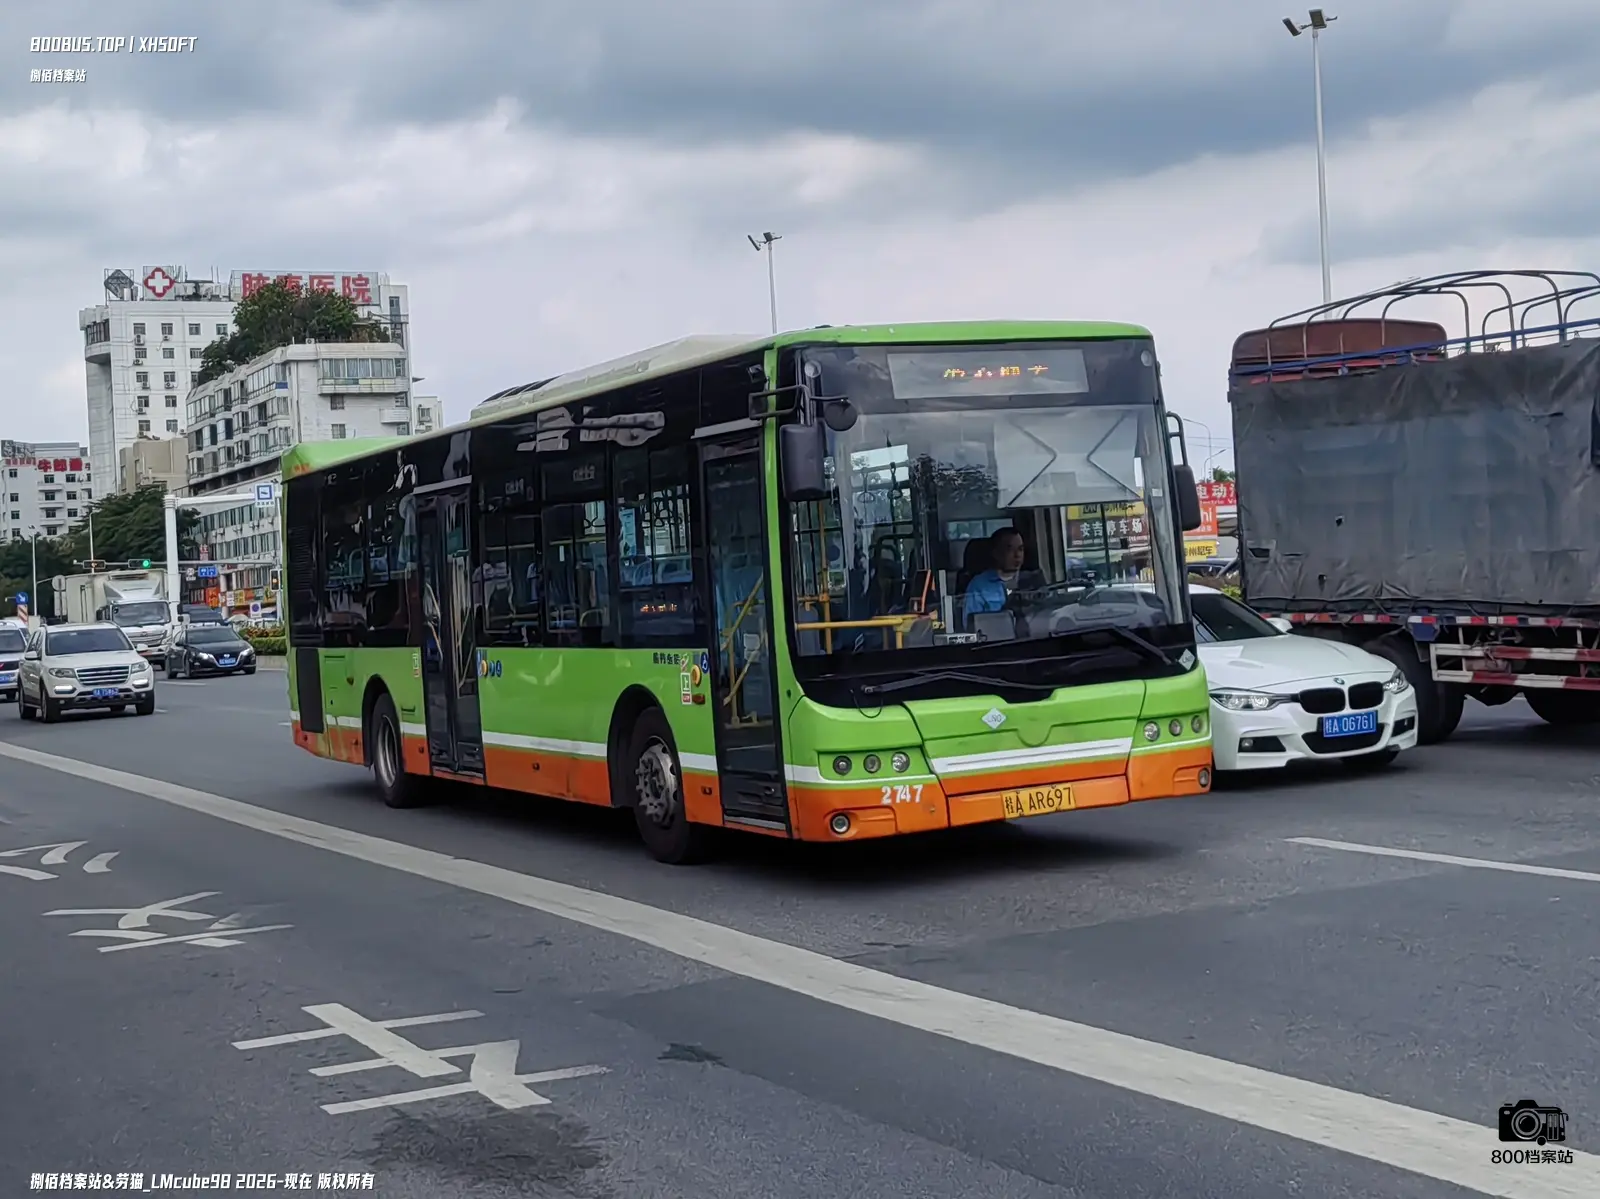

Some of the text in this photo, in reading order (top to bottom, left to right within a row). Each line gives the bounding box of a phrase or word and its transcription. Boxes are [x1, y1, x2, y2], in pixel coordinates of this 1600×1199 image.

[1197, 482, 1236, 499] 电动
[1080, 518, 1143, 537] 安吉停车场
[881, 784, 924, 805] 2747
